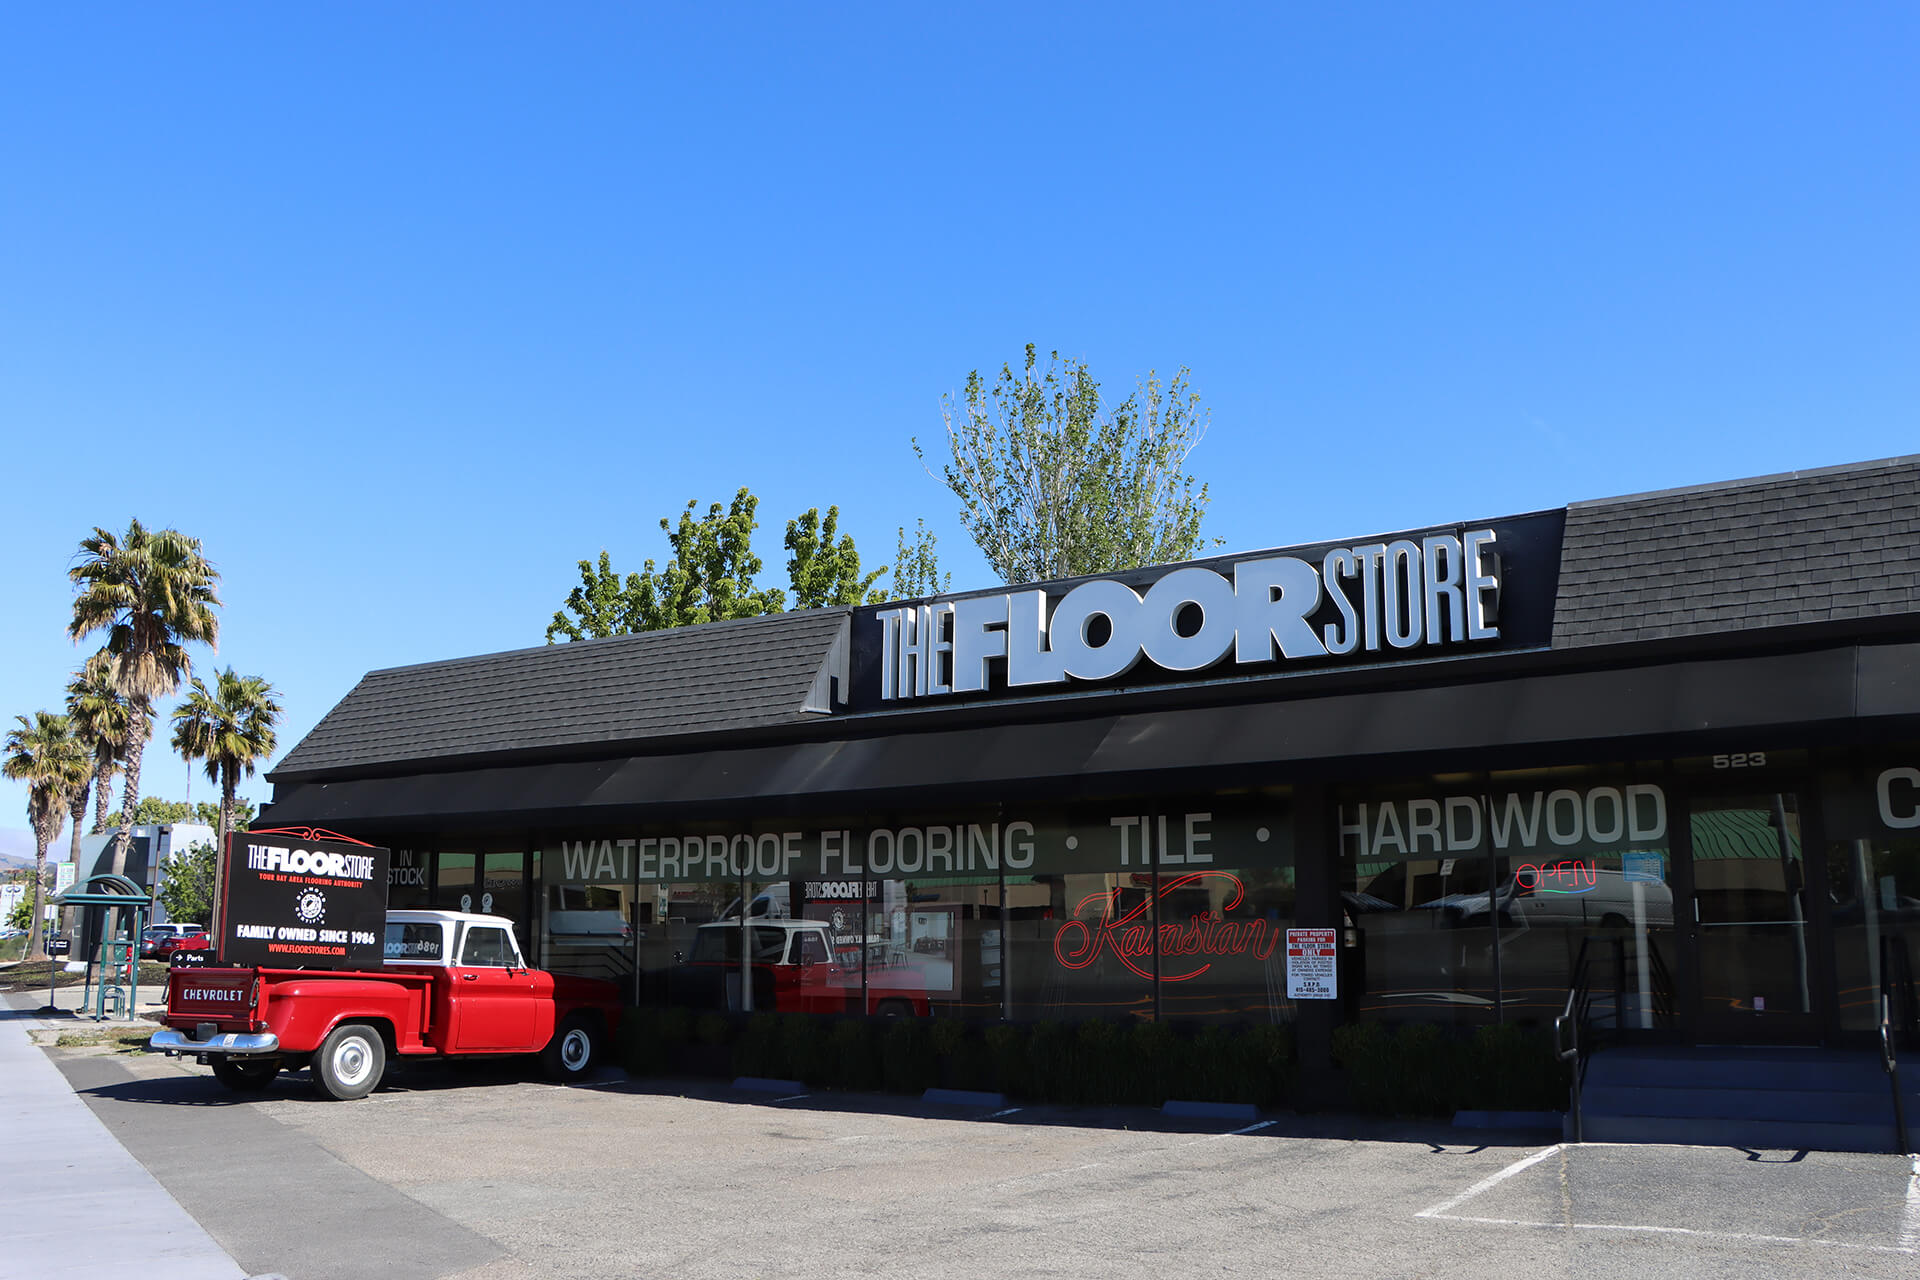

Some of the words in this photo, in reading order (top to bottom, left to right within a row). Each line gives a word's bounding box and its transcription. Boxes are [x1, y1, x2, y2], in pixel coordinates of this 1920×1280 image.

[1713, 752, 1766, 769] 523
[1338, 784, 1668, 857] HARDWOOD
[562, 832, 803, 880] WATERPROOF
[820, 821, 1036, 875] FLOORING
[1110, 812, 1214, 865] TILE
[400, 849, 413, 867] IN
[259, 873, 275, 881] YOUR
[276, 874, 287, 882] BAY
[289, 875, 303, 883] AREA
[305, 877, 332, 886] FLOORING
[333, 879, 363, 889] AUTHORITY
[387, 867, 425, 885] STOCK
[1516, 860, 1596, 888] OPEN
[236, 924, 277, 940] FAMILY
[278, 927, 317, 942] OWNED
[318, 929, 348, 944] SINCE
[350, 931, 376, 945] 1986
[1054, 870, 1279, 982] Karastan
[186, 954, 204, 962] Parts
[268, 943, 346, 956] WWW.FLOORSTORES.COM
[183, 989, 244, 1001] CHEVROLET
